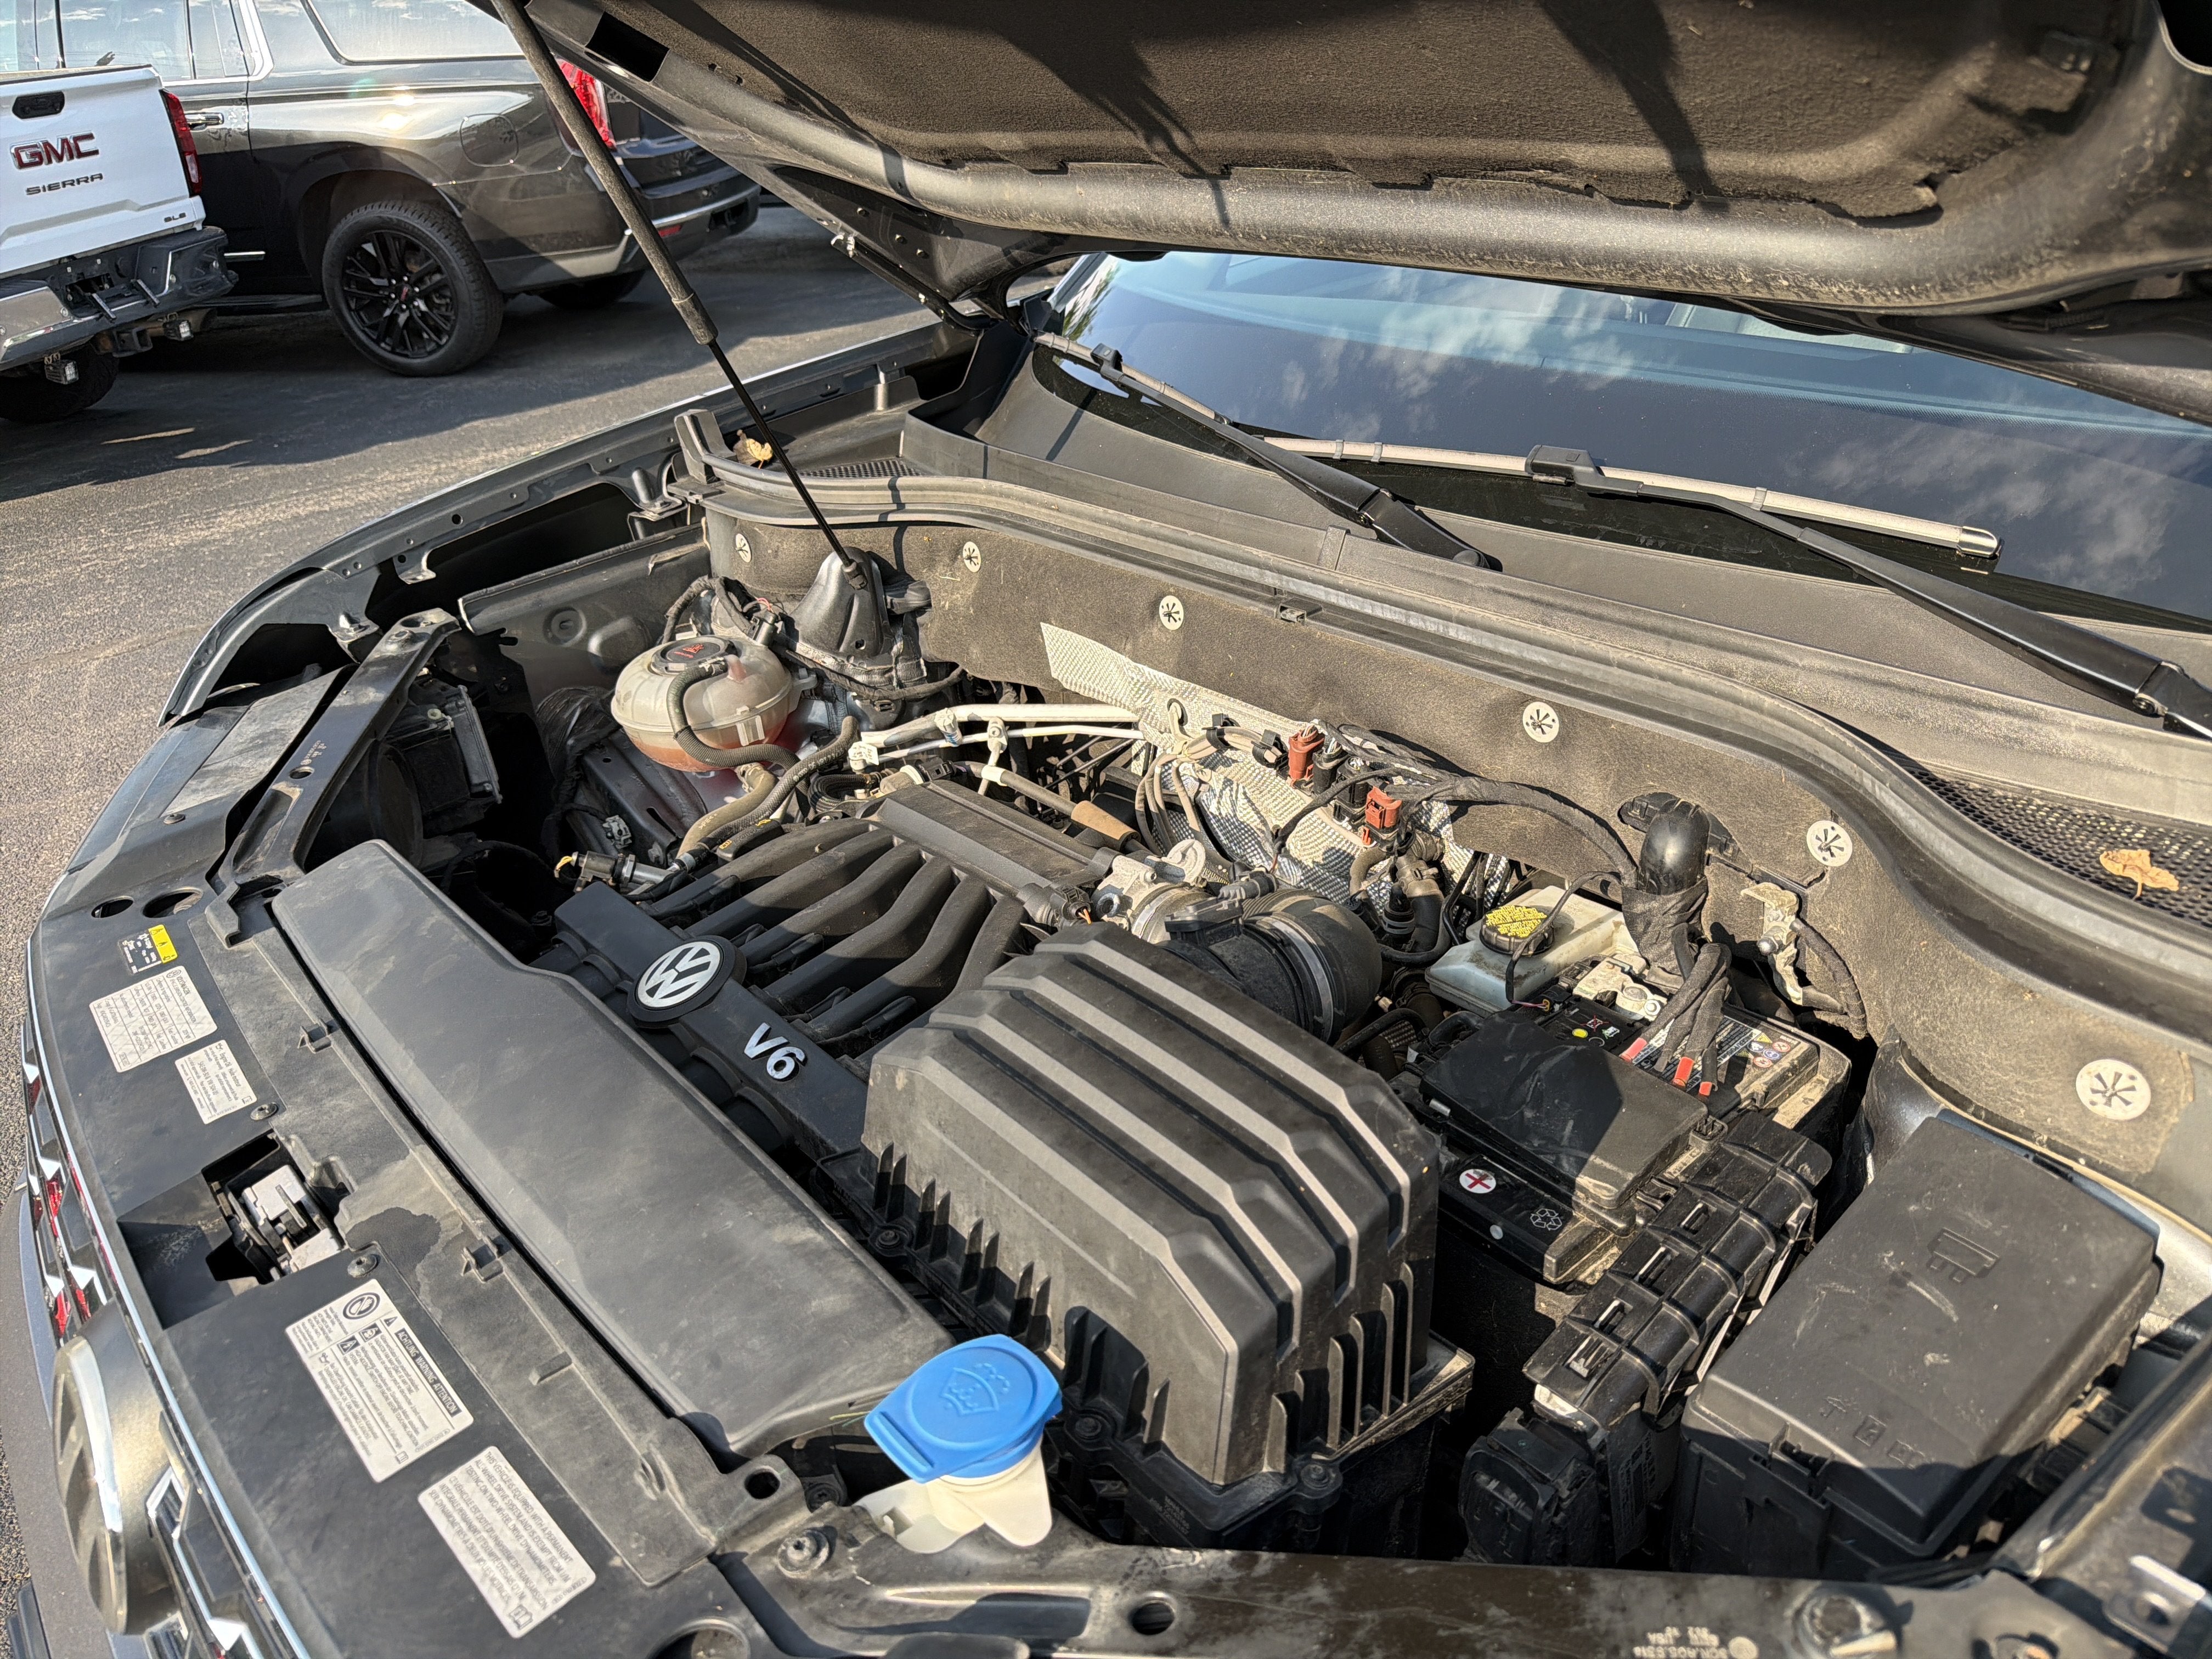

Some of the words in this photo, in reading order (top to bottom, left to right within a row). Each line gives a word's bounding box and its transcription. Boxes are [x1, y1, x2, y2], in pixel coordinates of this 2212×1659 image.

[10, 132, 99, 169] GMC
[26, 173, 103, 195] SIERRA
[743, 1022, 806, 1081] V6
[382, 1351, 391, 1359] FAN
[387, 1357, 396, 1367] MAY
[391, 1364, 402, 1375] START
[397, 1330, 420, 1357] ACHTUNG
[414, 1355, 438, 1384] WARNING
[432, 1381, 458, 1414] ATTENTION
[400, 1378, 409, 1386] ANY
[345, 1401, 354, 1410] CAN
[483, 1451, 497, 1465] THIS
[491, 1462, 512, 1485] VEHICLE
[506, 1481, 516, 1489] IS
[469, 1504, 481, 1515] EST
[509, 1486, 535, 1515] EQUIPPED
[455, 1505, 481, 1537] PERMANENT
[464, 1464, 484, 1487] TESTING
[478, 1483, 490, 1495] ON
[484, 1492, 514, 1526] TWO-WHEEL
[507, 1522, 525, 1542] DRIVE
[520, 1538, 558, 1585] DYNAMOMETERS.
[473, 1458, 499, 1487] ALL-WHEEL
[493, 1483, 510, 1502] DRIVE
[518, 1516, 533, 1532] AND
[527, 1528, 537, 1537] IS
[532, 1534, 552, 1558] EXEMPT
[547, 1554, 565, 1573] FROM
[529, 1511, 546, 1528] WITH
[540, 1525, 550, 1534] A
[544, 1529, 574, 1565] PERMANENT
